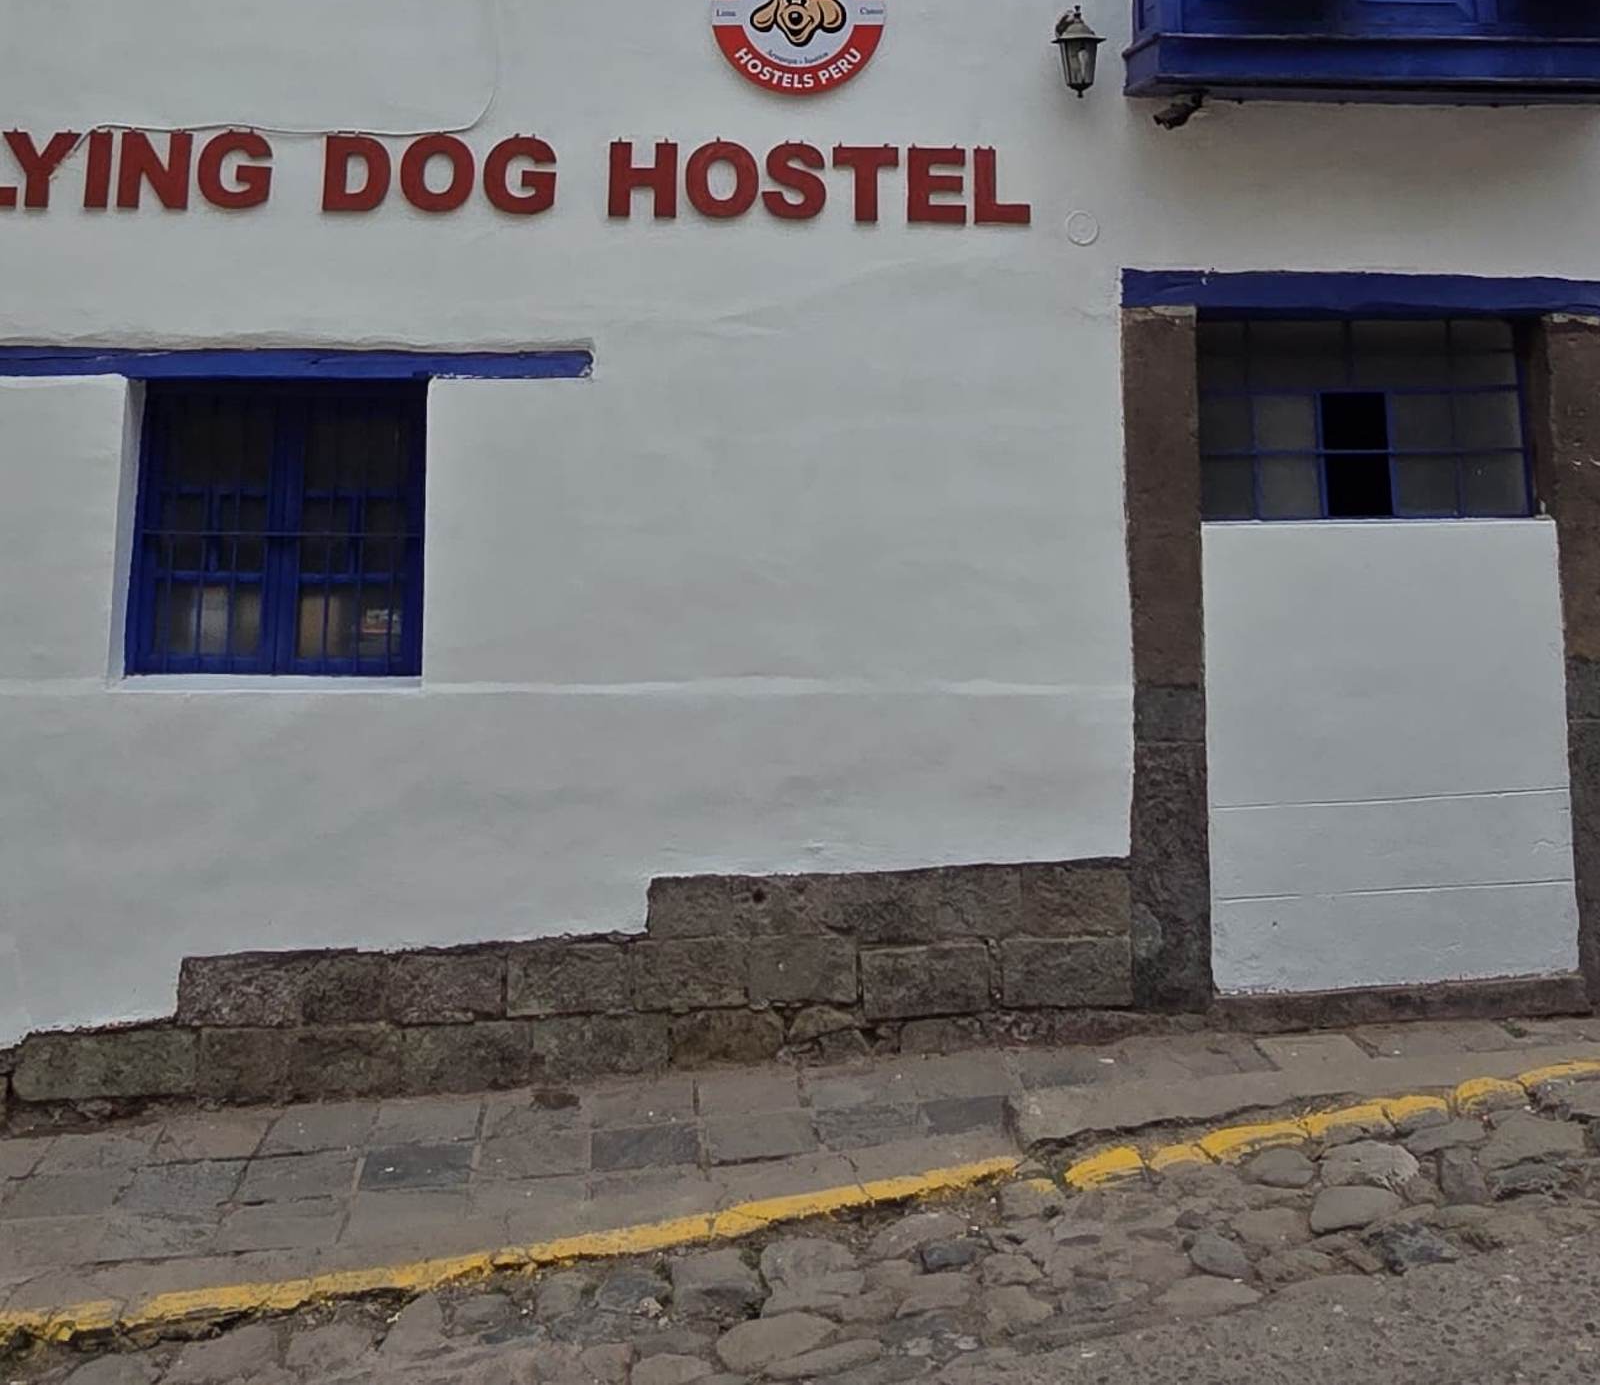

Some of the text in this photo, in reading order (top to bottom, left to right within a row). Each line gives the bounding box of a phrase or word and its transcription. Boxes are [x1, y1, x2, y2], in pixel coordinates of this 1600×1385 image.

[734, 47, 862, 89] HOSTELS PERU
[322, 133, 558, 213] DOG
[607, 141, 1031, 224] HOSTEL
